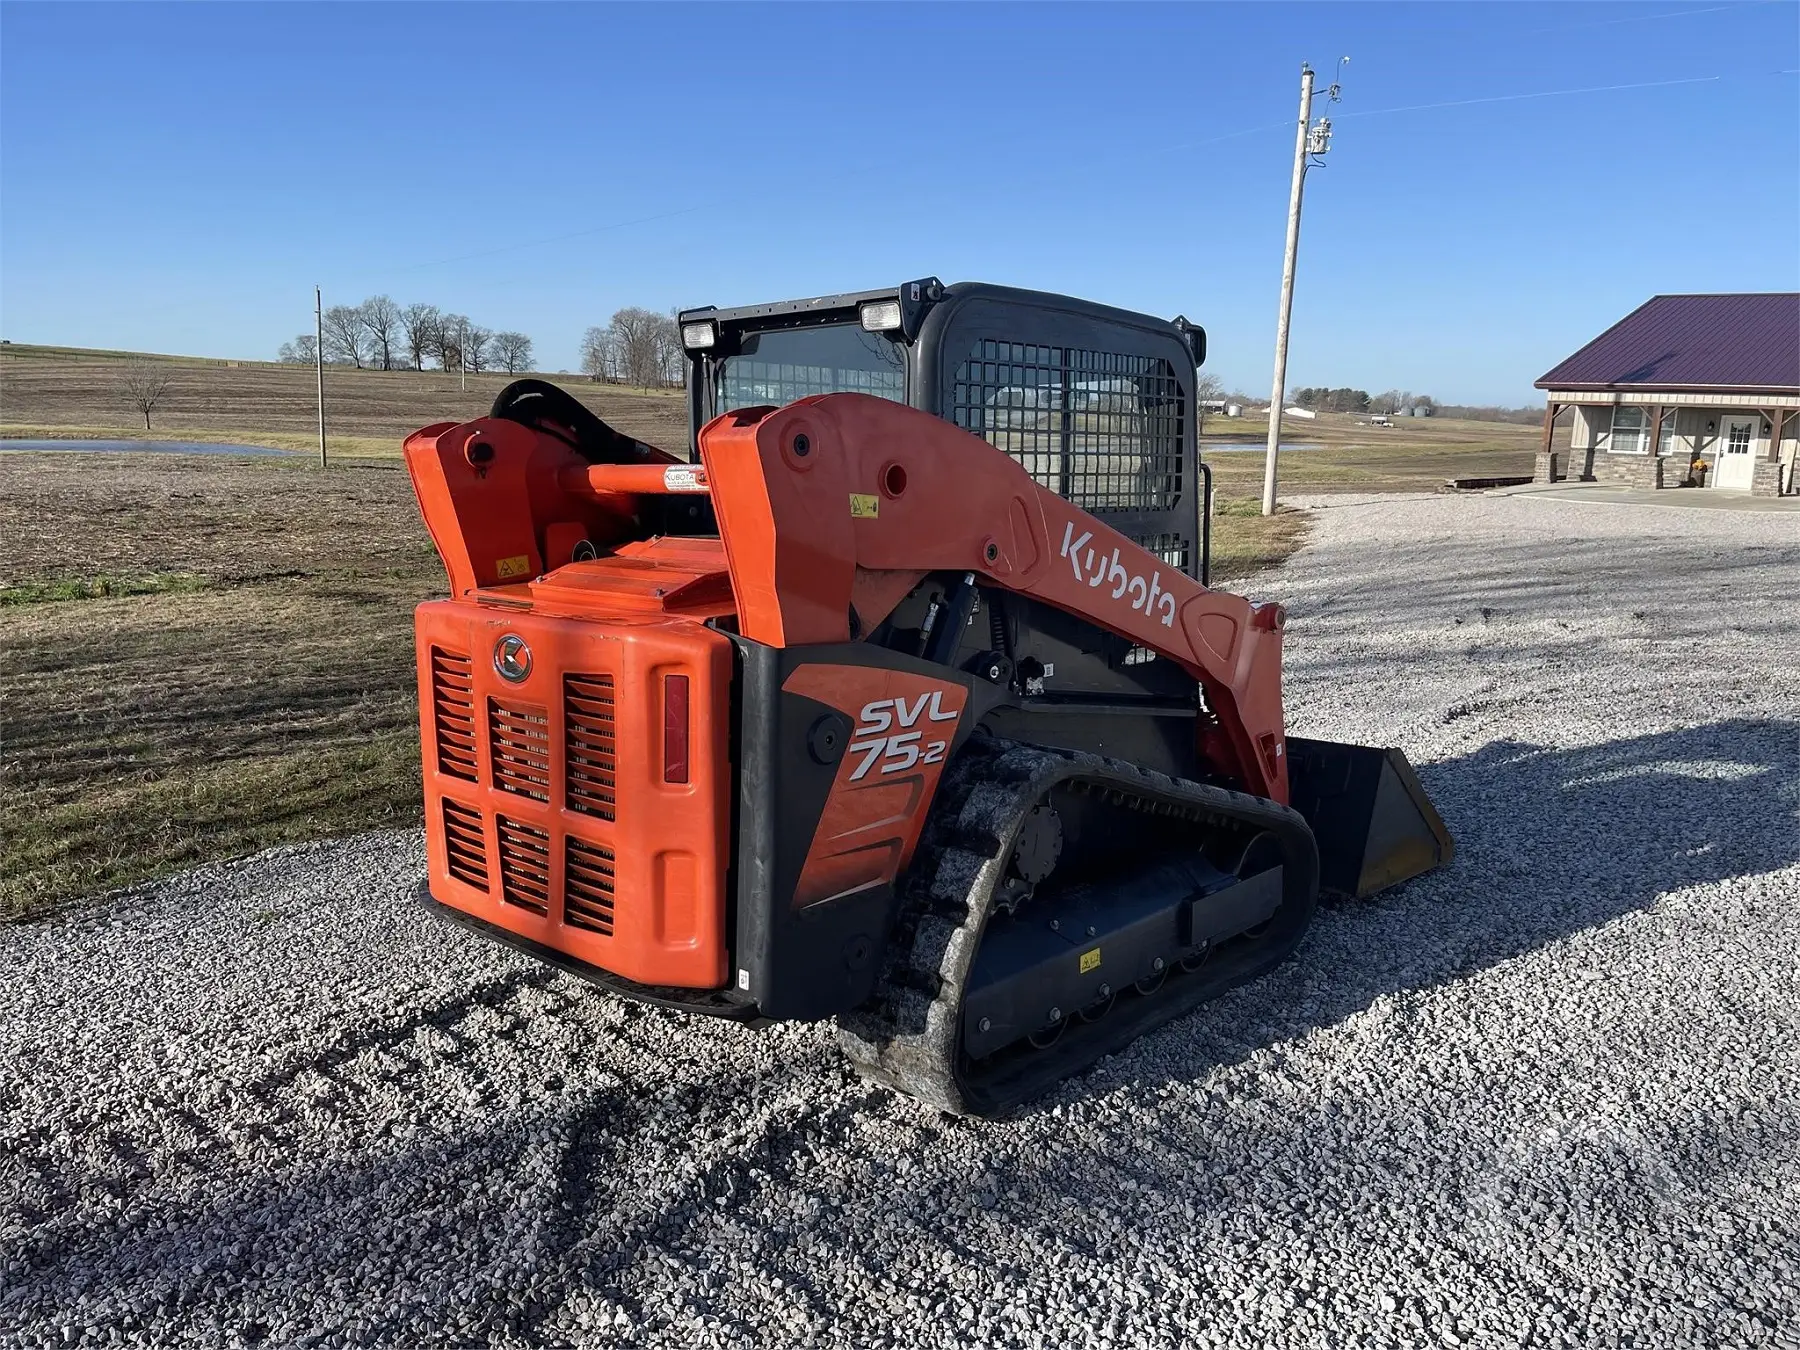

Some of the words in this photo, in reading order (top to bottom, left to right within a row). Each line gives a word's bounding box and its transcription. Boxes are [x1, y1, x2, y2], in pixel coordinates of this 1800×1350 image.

[666, 473, 694, 481] KUBOTA
[1060, 521, 1176, 628] Kubota
[855, 690, 958, 737] SVL
[849, 730, 946, 781] 75-2
